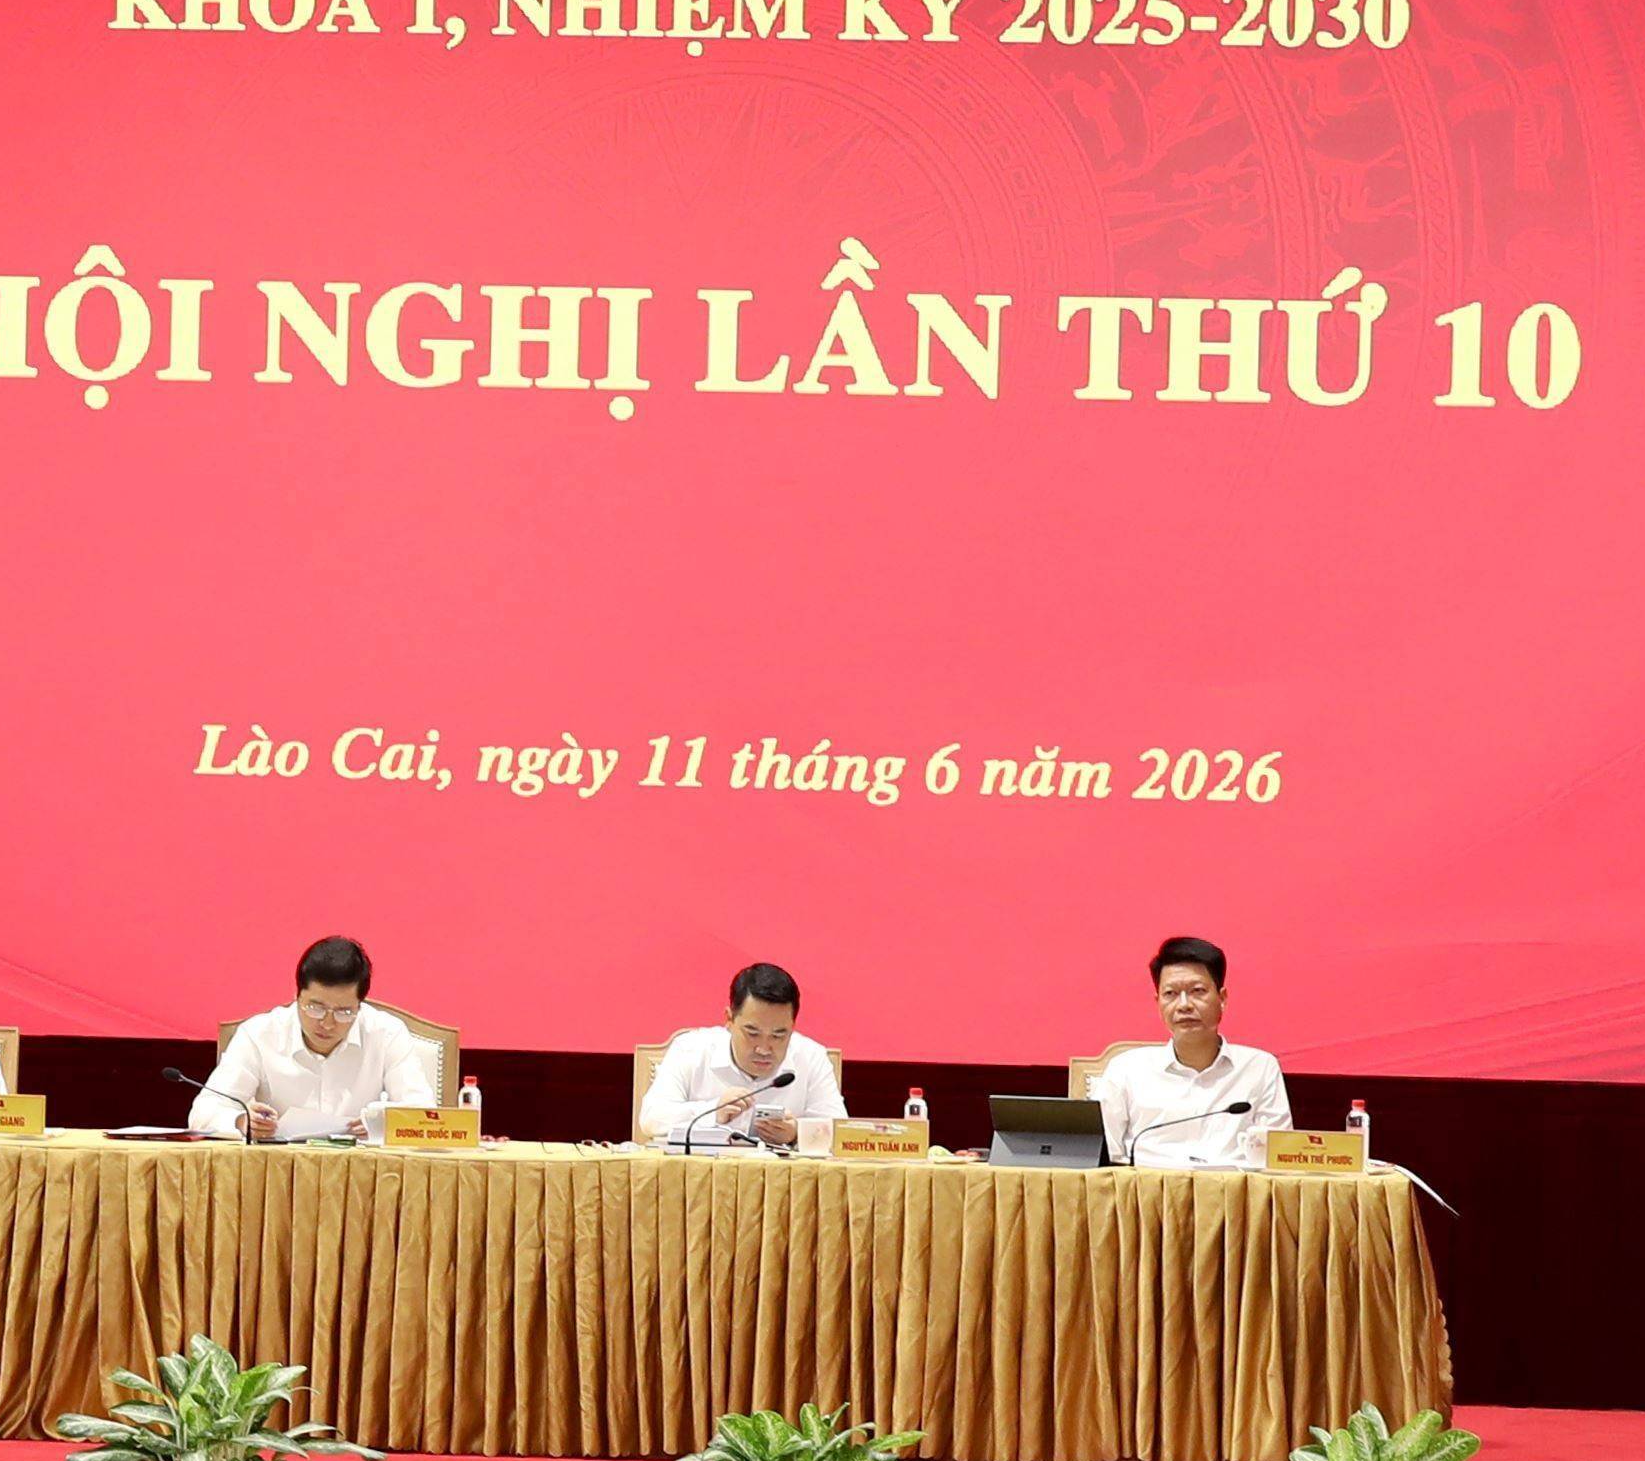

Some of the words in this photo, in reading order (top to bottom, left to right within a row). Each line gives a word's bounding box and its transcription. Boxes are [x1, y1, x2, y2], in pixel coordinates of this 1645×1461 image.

[254, 281, 652, 420] NGHỊ
[695, 237, 1011, 399] LẦN
[1058, 267, 1387, 406] THỨ
[1434, 302, 1580, 409] 10
[194, 725, 309, 777] Lào
[332, 728, 451, 790] Cai,
[477, 733, 618, 798] ngày
[639, 736, 706, 786] 11
[730, 738, 906, 806] tháng
[926, 743, 960, 794] 6
[980, 746, 1111, 798] năm
[1132, 748, 1282, 802] 2026
